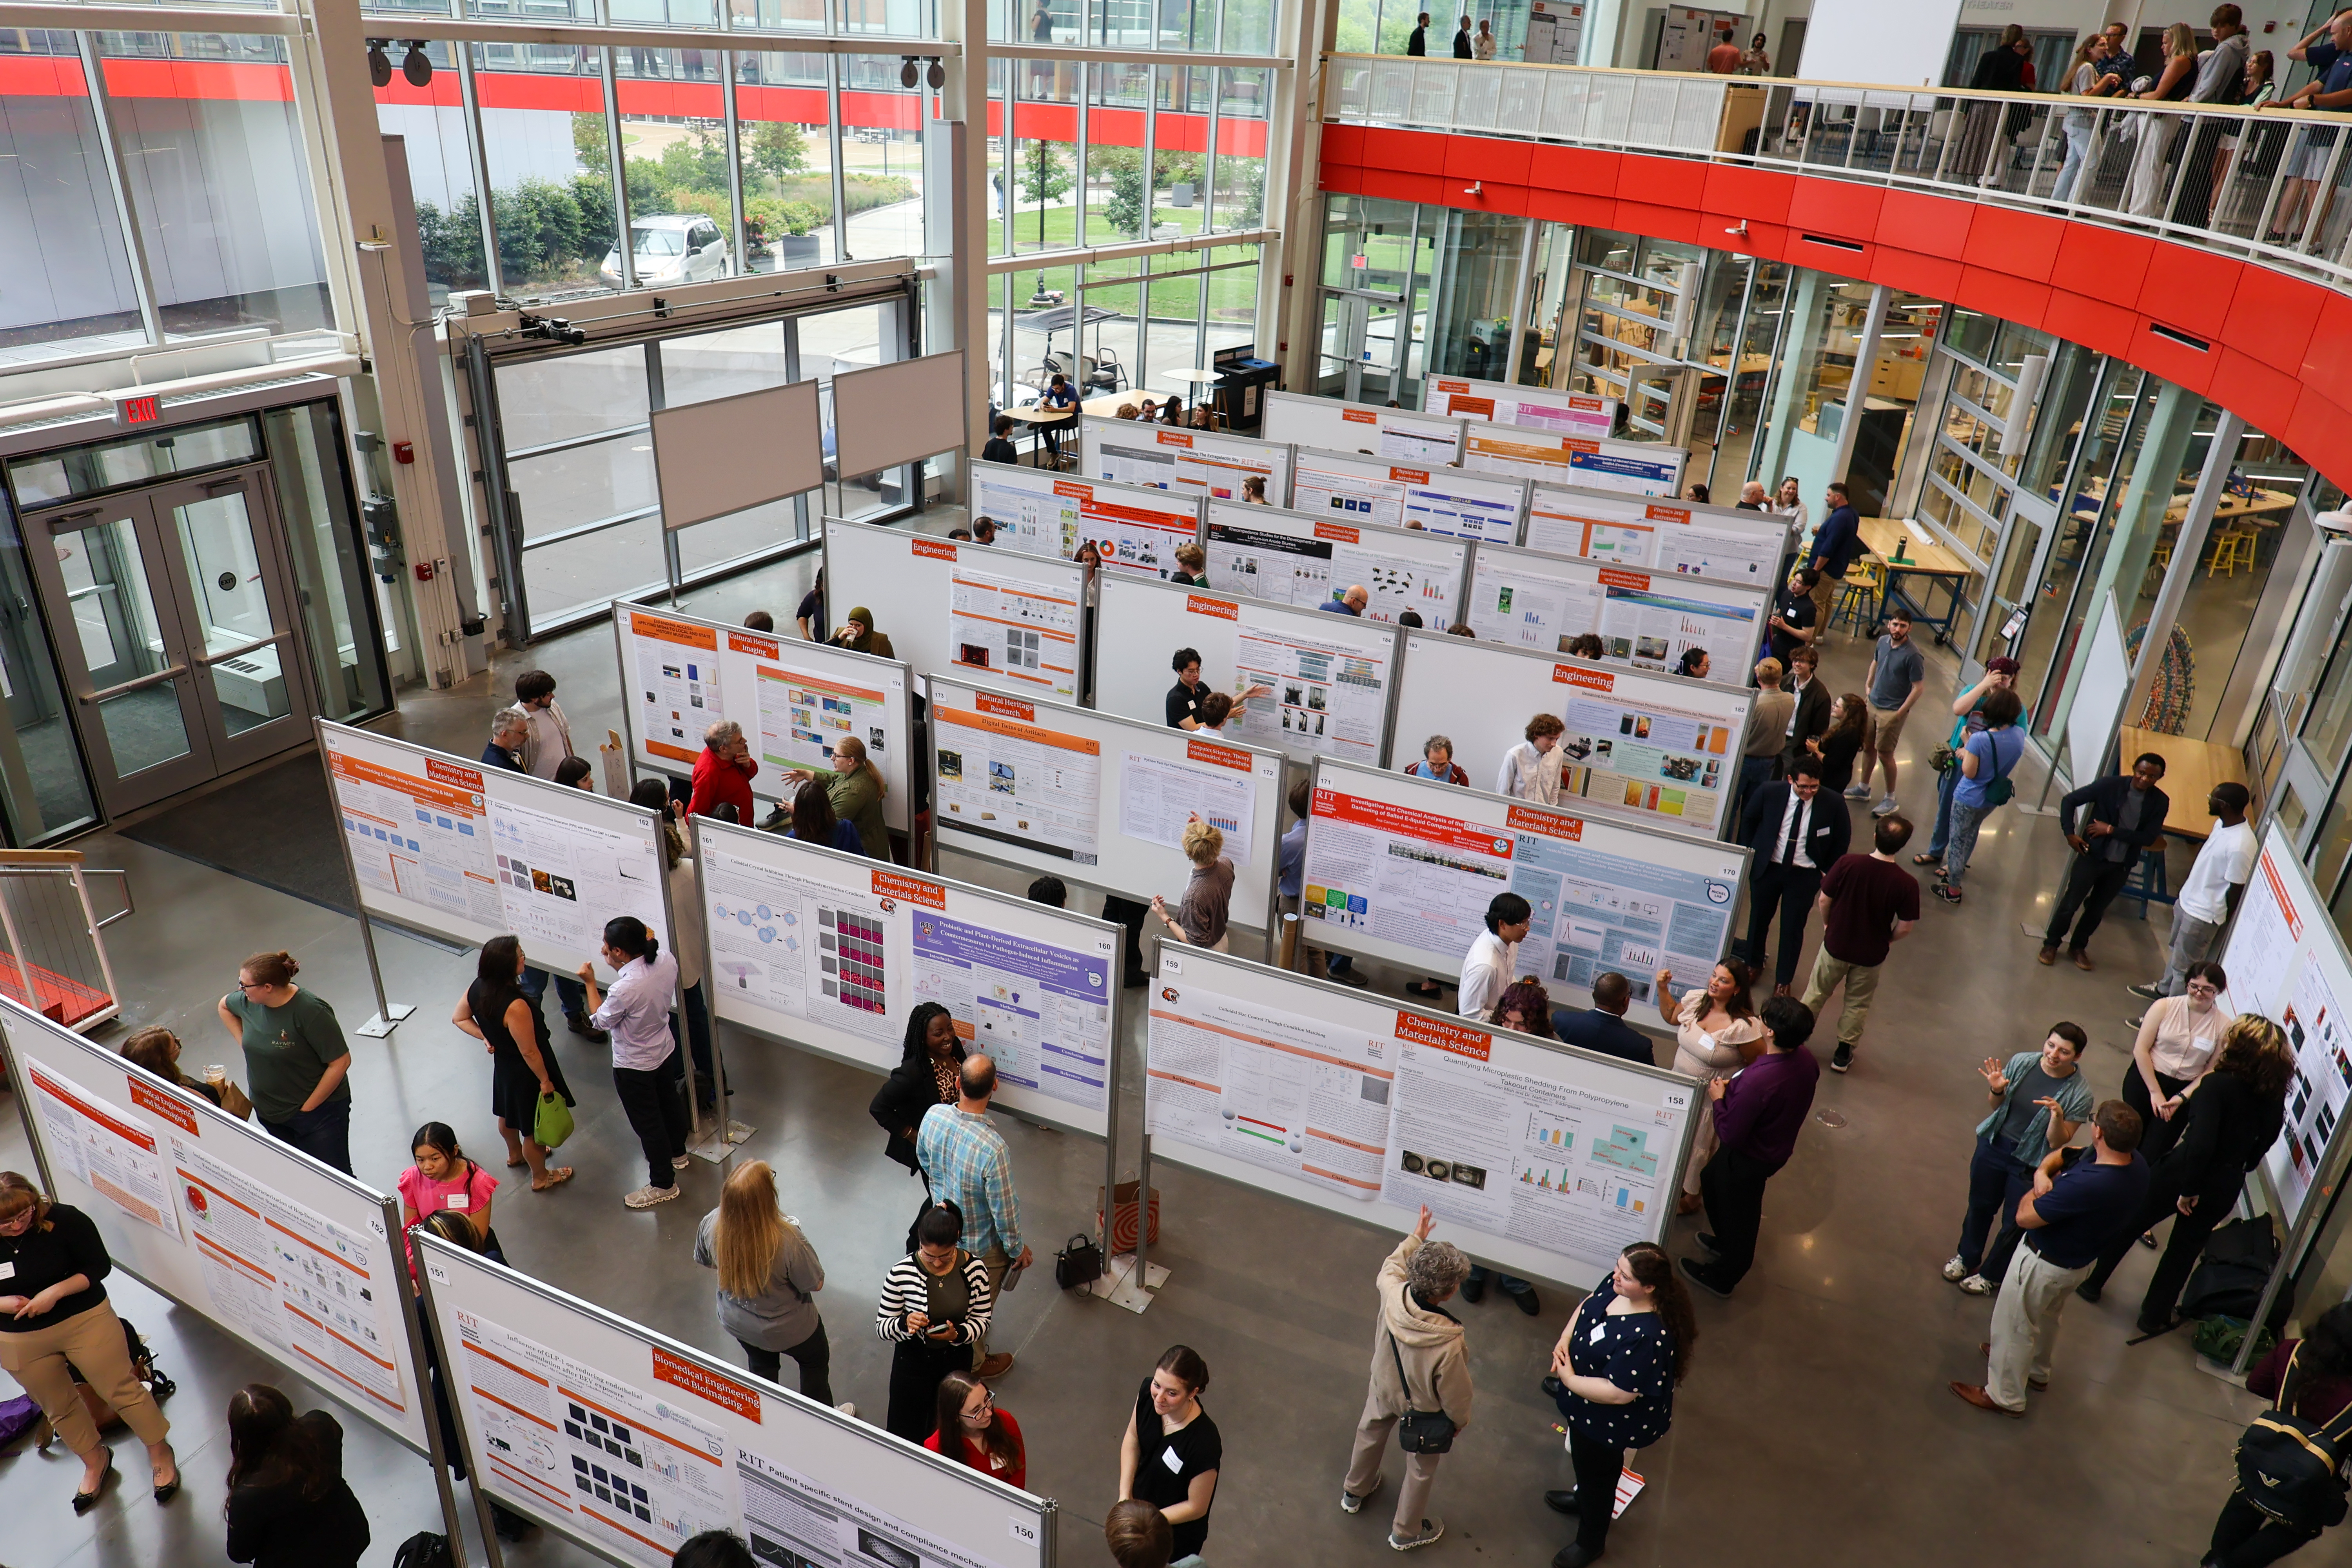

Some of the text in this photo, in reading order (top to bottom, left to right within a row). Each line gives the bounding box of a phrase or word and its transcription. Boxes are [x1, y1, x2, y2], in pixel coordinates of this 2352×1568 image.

[1967, 0, 2013, 10] THEATER
[126, 397, 157, 423] EXIT
[1572, 403, 1598, 412] Anthropology
[1396, 475, 1422, 484] Astronomy
[1066, 490, 1088, 498] Sustainability
[1653, 514, 1681, 523] Astronomy
[1229, 527, 1258, 536] Rheoimpedance
[1328, 532, 1354, 541] Sustainability
[913, 543, 956, 559] Engineering
[1601, 571, 1631, 579] Enviornmental
[1614, 579, 1642, 588] Sustainability
[1189, 599, 1237, 618] Engineering
[730, 633, 778, 649] Cultural Heritage
[742, 644, 766, 656] Imaging
[1555, 669, 1613, 689] Engineering
[977, 693, 1033, 711] Cultural Heritage
[991, 705, 1020, 717] Research
[982, 718, 998, 728] Digital
[1001, 722, 1015, 731] Twins
[1024, 727, 1046, 738] Artifacts
[1189, 744, 1251, 761] Computer Science, Theory,
[1191, 750, 1249, 767] Mathematics, Algorithms
[431, 762, 462, 777] Chemistry
[429, 771, 483, 790] Materials Science
[1316, 790, 1336, 800] RIT
[1351, 798, 1383, 809] Investigative
[1397, 808, 1421, 817] Chemical
[1423, 813, 1446, 823] Analysis
[1351, 804, 1377, 815] Darkening
[1405, 816, 1425, 825] E-liquid
[1427, 821, 1461, 833] Components
[1516, 809, 1557, 826] Chemistry
[1509, 818, 1579, 838] Materials Science
[879, 875, 937, 894] Chemistry and
[874, 884, 944, 907] Materials Science
[940, 921, 962, 932] Probiotic
[975, 931, 1011, 945] Plant-Derived
[1013, 940, 1047, 954] Extracellular
[1050, 950, 1071, 960] Vesicles
[940, 930, 983, 946] Countermeasures
[992, 944, 1039, 961] Pathogen-Induced
[1041, 956, 1078, 971] Inflammation
[1165, 960, 1178, 969] 159
[1218, 1007, 1237, 1015] Colloidal
[1265, 1018, 1282, 1027] Through
[1284, 1023, 1304, 1032] Condition
[1306, 1029, 1325, 1038] Matching
[1407, 1016, 1481, 1042] Chemistry and
[1368, 1040, 1385, 1049] RIT
[1398, 1027, 1487, 1057] Materials Science
[1444, 1056, 1629, 1108] Quantifying Microplastic Shedding From Polypropylene
[1501, 1080, 1566, 1100] Takeout Containers
[130, 1080, 196, 1121] Biomedical Engineering
[1668, 1096, 1684, 1105] 158
[143, 1099, 187, 1126] and Bioimaging
[370, 1220, 385, 1234] 152
[430, 1267, 445, 1279] 151
[457, 1310, 479, 1328] RIT
[654, 1353, 759, 1409] Biomedical Engineering
[673, 1376, 742, 1412] and Bioimaging
[739, 1449, 765, 1468] RIT
[769, 1466, 987, 1568] Patient specific stent design and compliance mechan
[1014, 1525, 1034, 1539] 150
